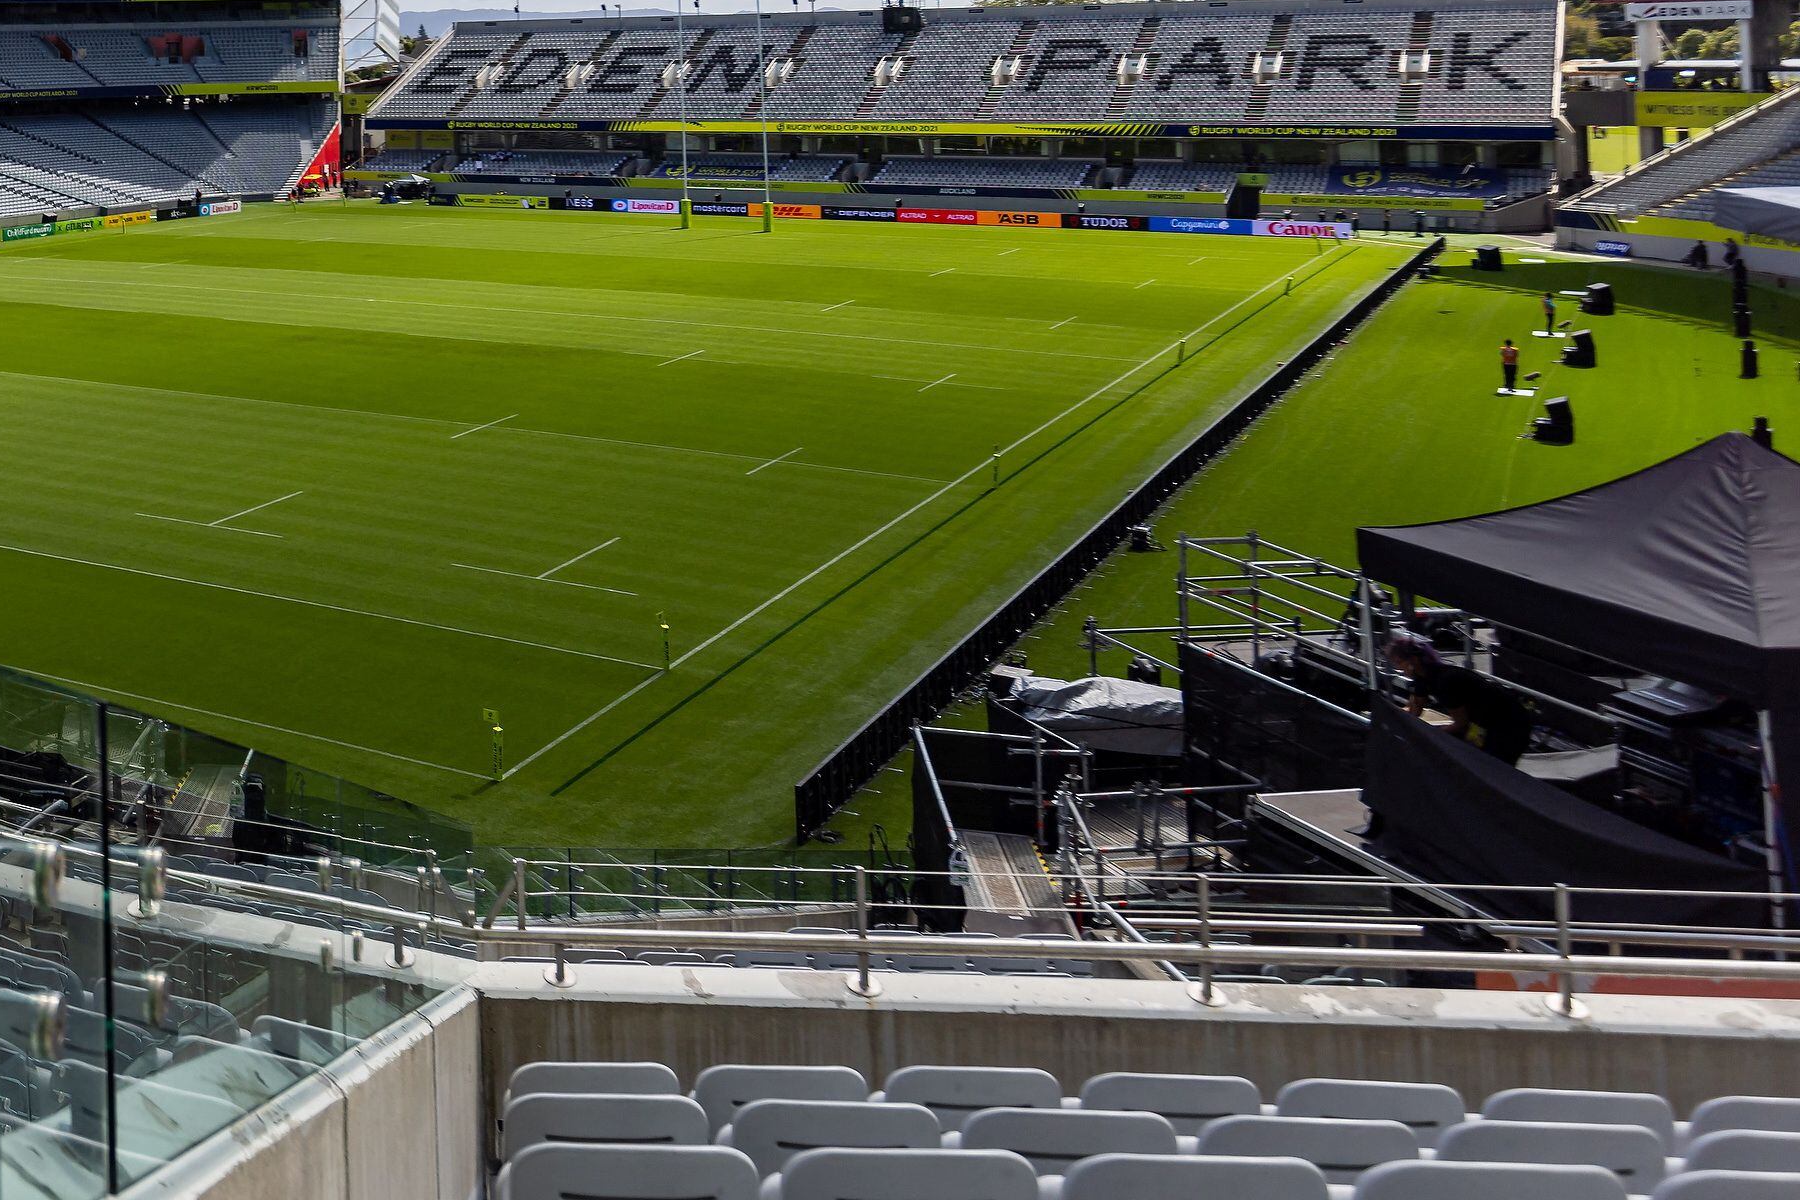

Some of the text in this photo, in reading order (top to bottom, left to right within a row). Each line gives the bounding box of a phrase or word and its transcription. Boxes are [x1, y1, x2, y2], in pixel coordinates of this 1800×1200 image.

[1658, 5, 1748, 16] EDEN PARK
[1024, 30, 1530, 93] PARK
[412, 45, 775, 94] EDEN
[1644, 104, 1718, 115] WITNESS THE
[233, 202, 238, 210] D
[566, 199, 593, 208] INEOS
[667, 202, 674, 210] D
[693, 204, 746, 213] mastercard
[838, 210, 895, 218] DEFENDER
[1000, 214, 1039, 225] ASB
[1080, 217, 1129, 228] TUDOR
[1170, 219, 1219, 232] Capgemini
[1269, 221, 1336, 236] Canon
